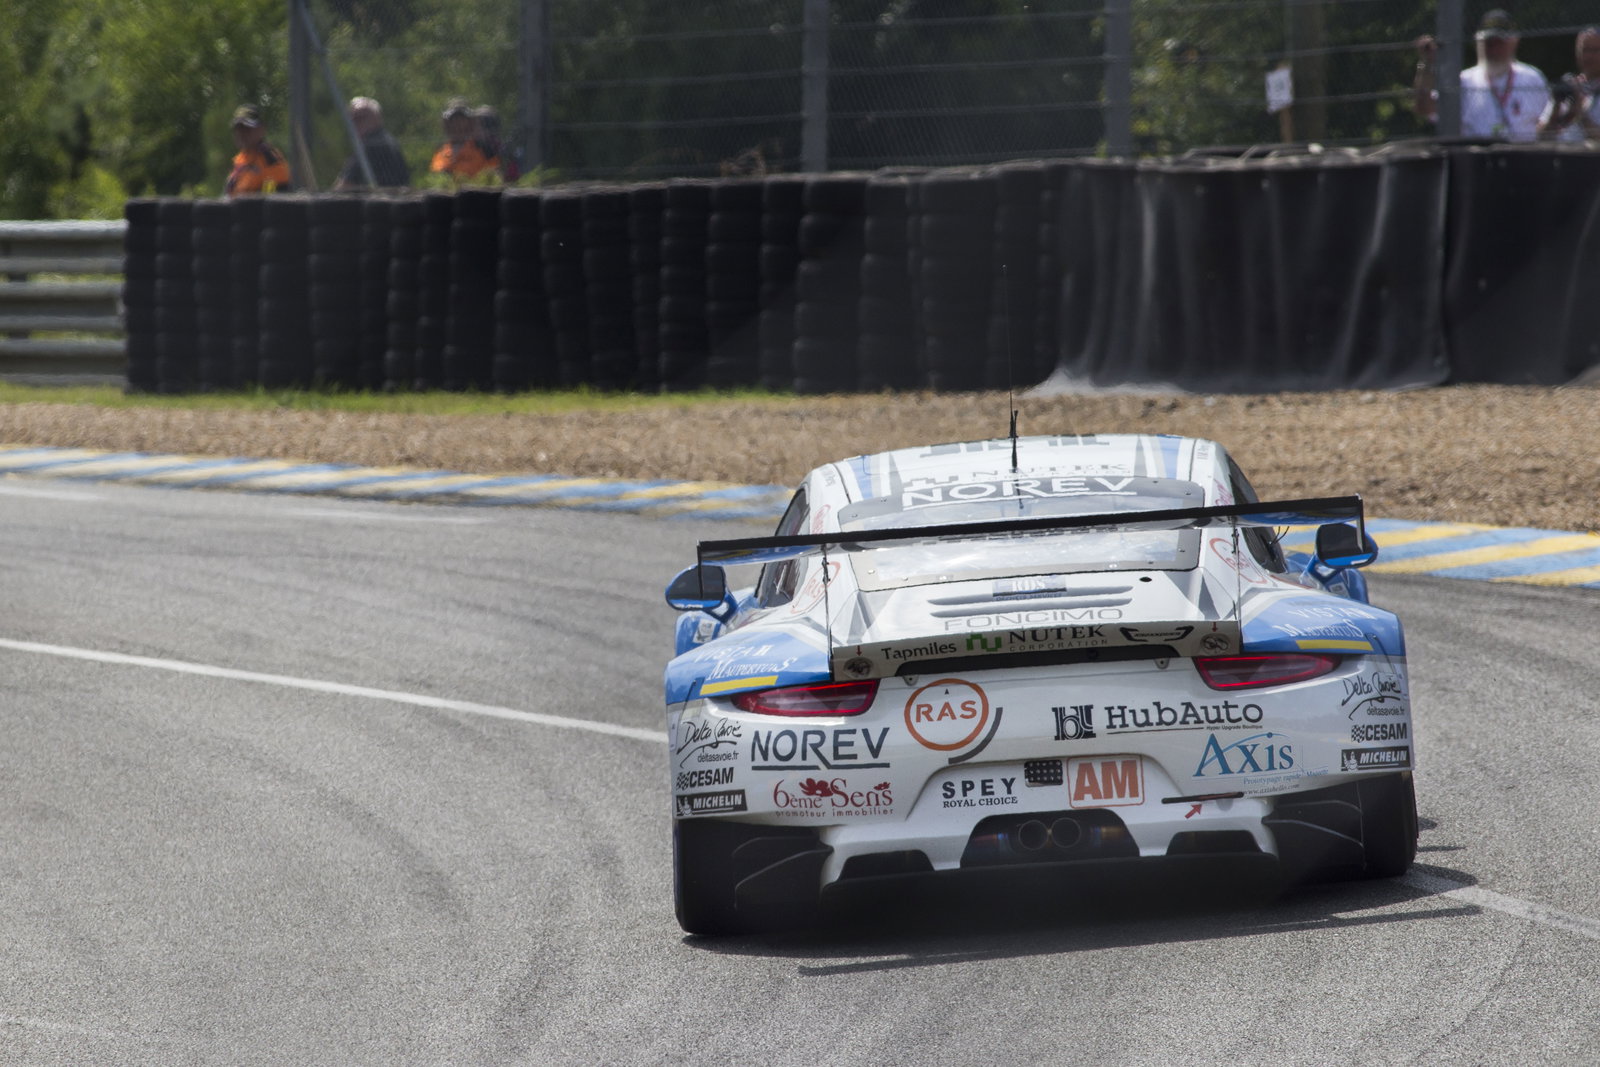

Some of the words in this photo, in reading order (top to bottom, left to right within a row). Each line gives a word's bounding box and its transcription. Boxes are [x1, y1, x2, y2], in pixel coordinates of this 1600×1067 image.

[902, 477, 1137, 507] NOREV
[944, 607, 1123, 631] FONCIMO
[1008, 625, 1105, 644] NUTEK
[881, 641, 957, 661] Tapmiles
[1009, 639, 1108, 652] CORPORATION
[915, 700, 978, 722] RAS
[1104, 700, 1264, 729] HubAuto
[1365, 723, 1407, 740] CESAM
[751, 727, 890, 763] NOREV
[1192, 733, 1294, 777] Axis
[698, 751, 739, 762] deltasavoie.fr
[1360, 751, 1407, 763] MICHELIN
[690, 767, 734, 788] CESAM
[942, 777, 1016, 799] SPEY
[1072, 760, 1140, 801] AM
[694, 794, 742, 809] MICHELIN
[830, 778, 893, 808] Sens
[942, 798, 976, 809] ROYAL
[978, 796, 1018, 806] CHOICE
[776, 809, 826, 818] promoteur
[833, 808, 893, 817] immobilier
